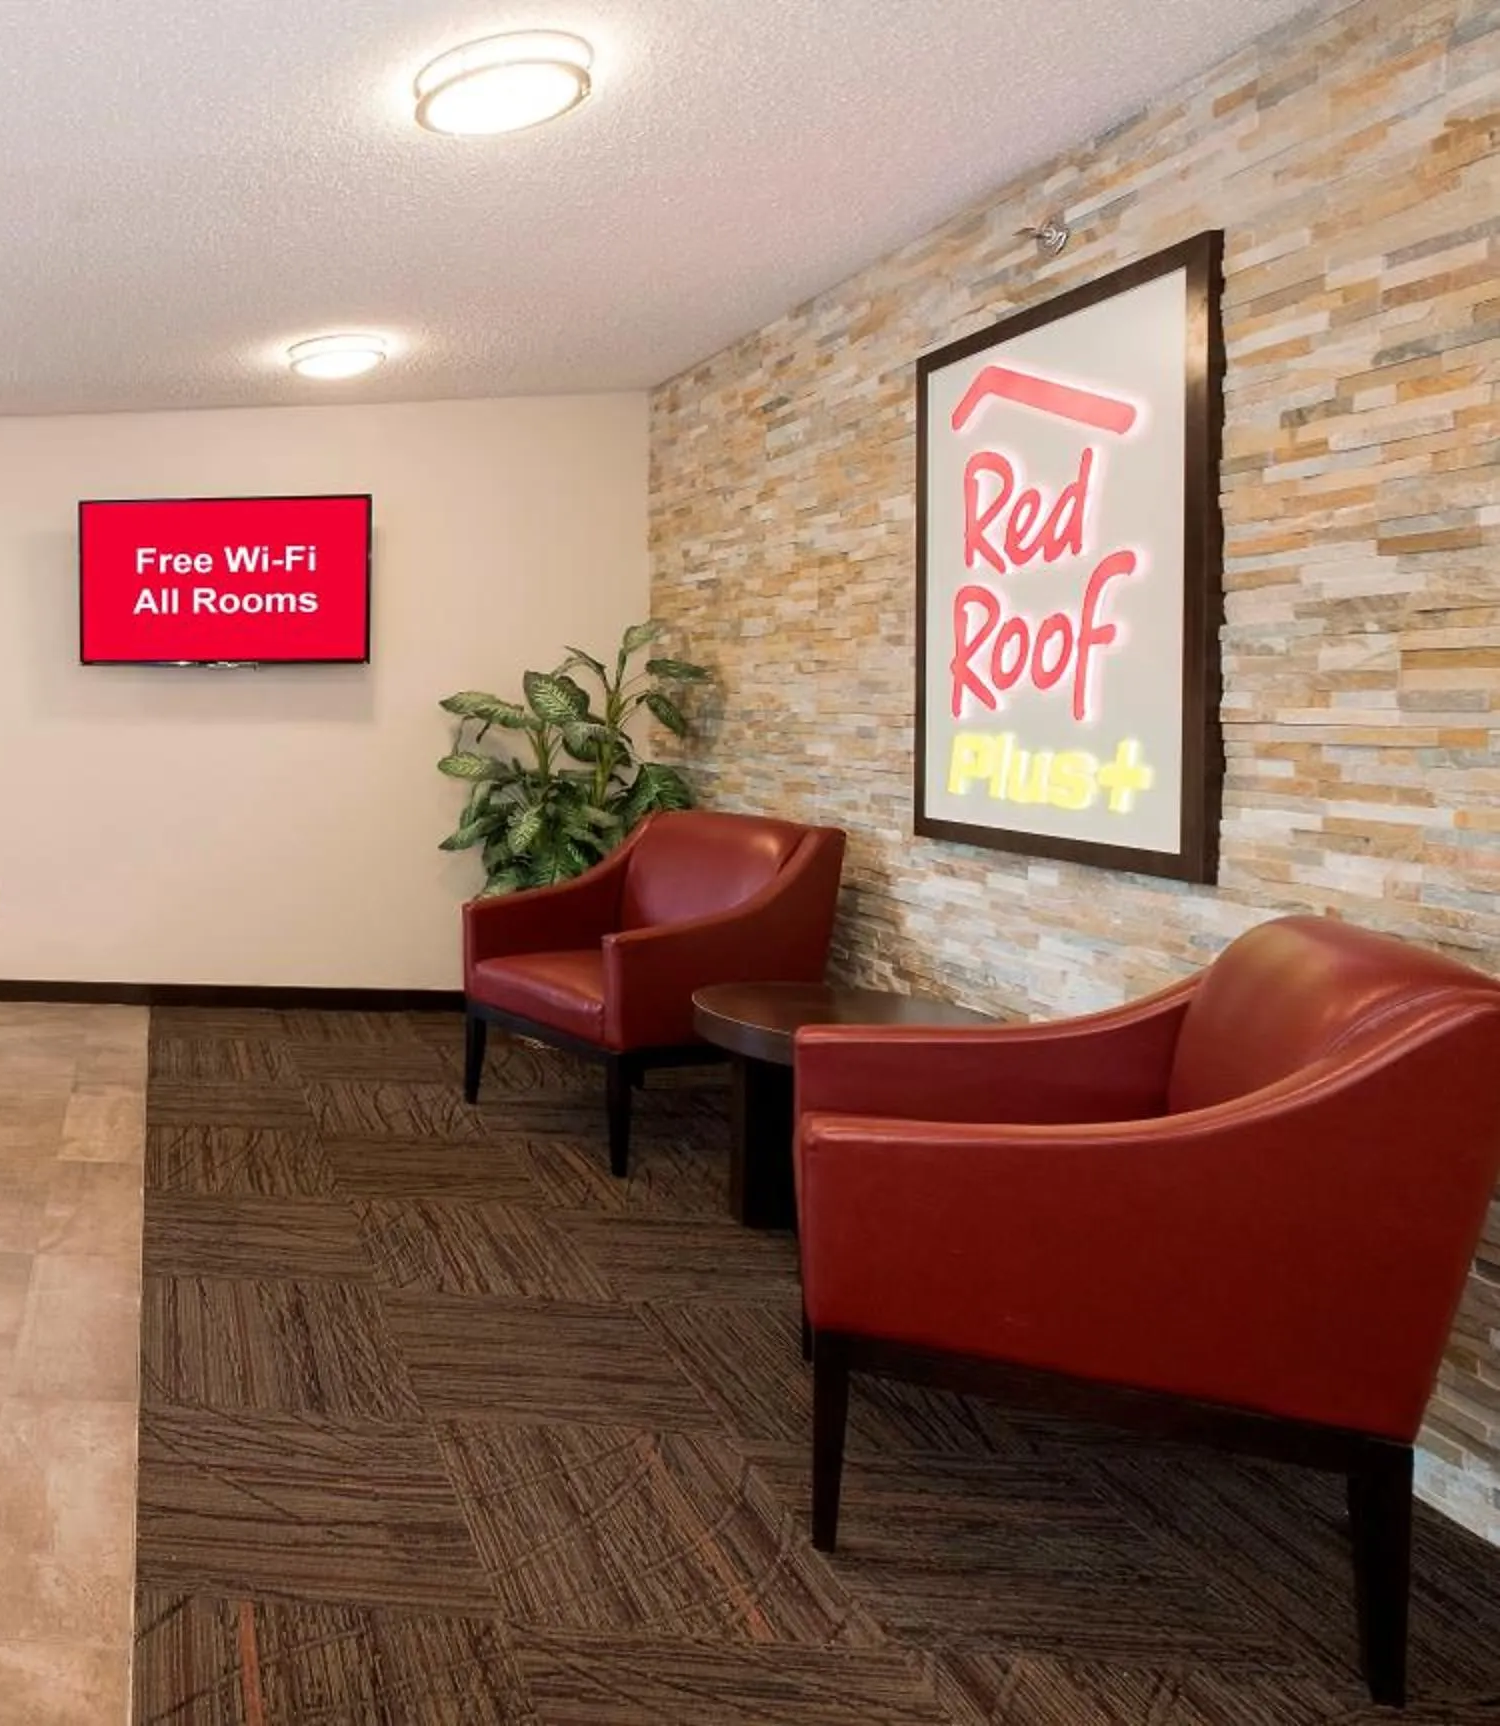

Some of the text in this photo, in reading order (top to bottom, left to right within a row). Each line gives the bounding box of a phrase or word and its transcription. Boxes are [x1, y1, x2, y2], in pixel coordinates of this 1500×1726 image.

[963, 447, 1094, 574] Red
[136, 545, 316, 574] Free Wi-Fi
[133, 587, 318, 615] All Rooms
[950, 549, 1137, 721] Roof
